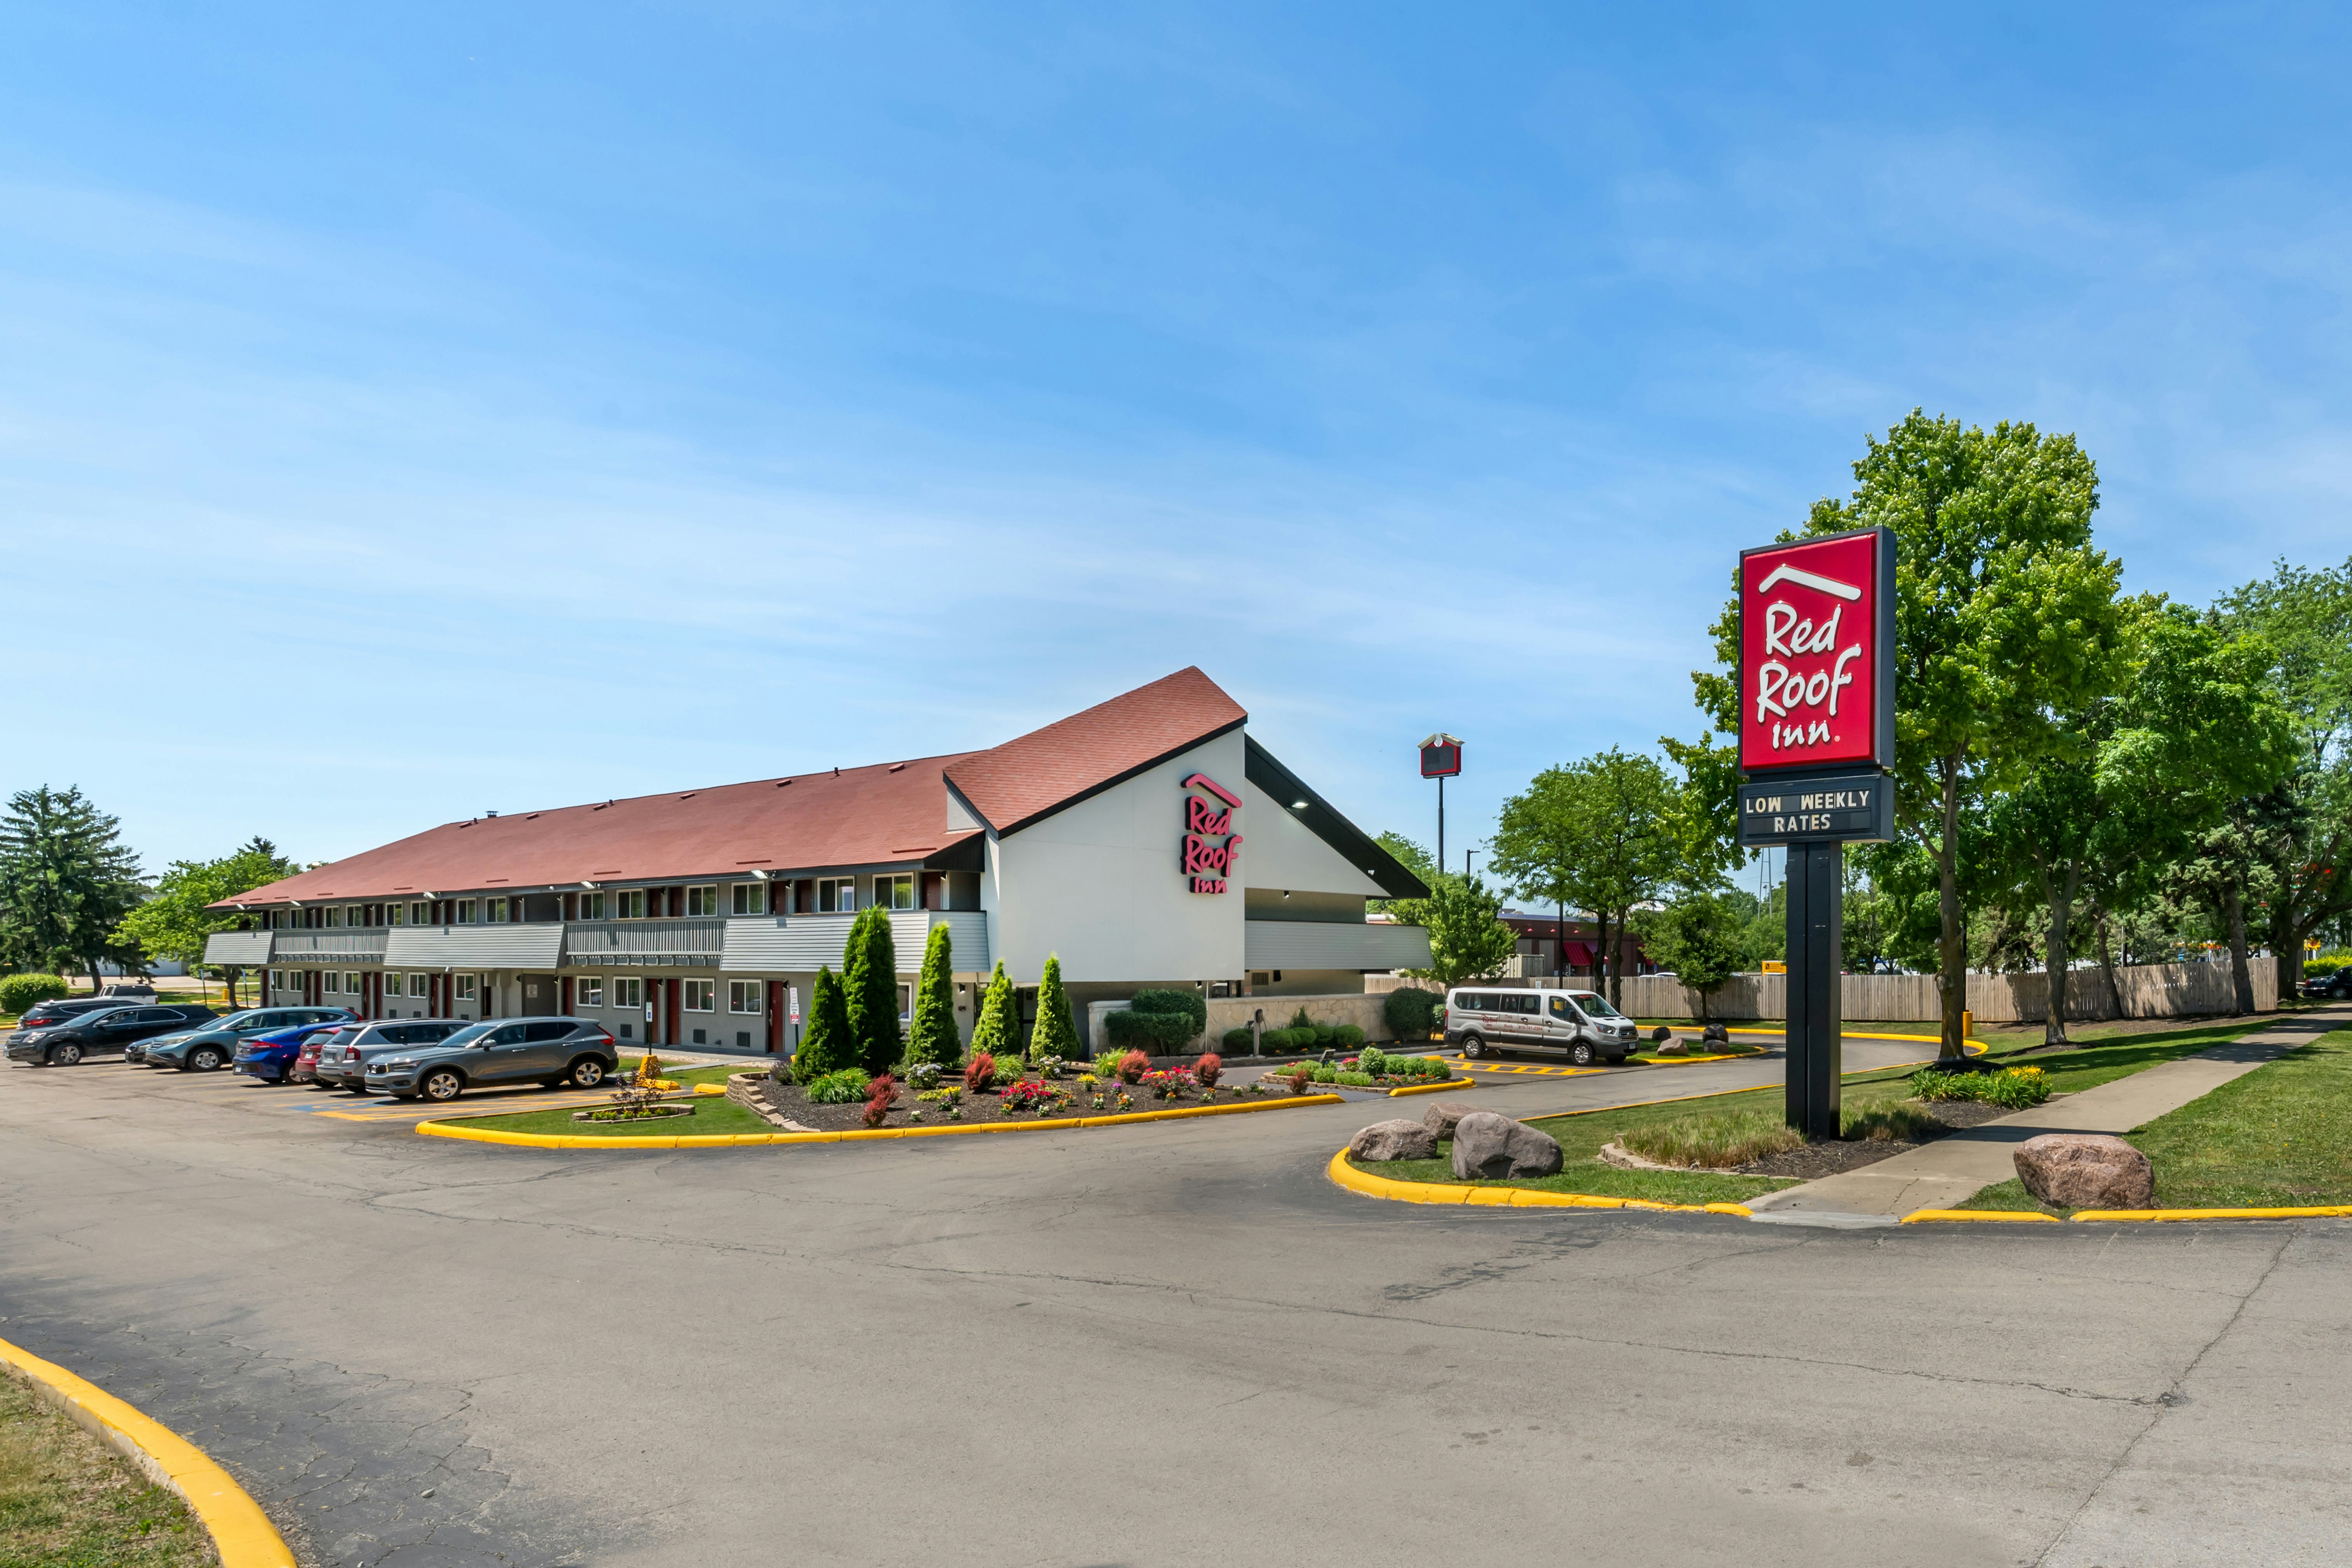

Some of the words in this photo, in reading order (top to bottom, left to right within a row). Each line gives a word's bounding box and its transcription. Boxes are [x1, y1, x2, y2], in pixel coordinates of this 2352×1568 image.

[1766, 601, 1841, 657] Red
[1757, 644, 1862, 723] Roof
[1185, 796, 1232, 835] Red
[1746, 796, 1781, 813] LOW
[1801, 791, 1870, 810] WEEKLY
[1774, 813, 1830, 832] RATES
[1181, 834, 1243, 877] Roof
